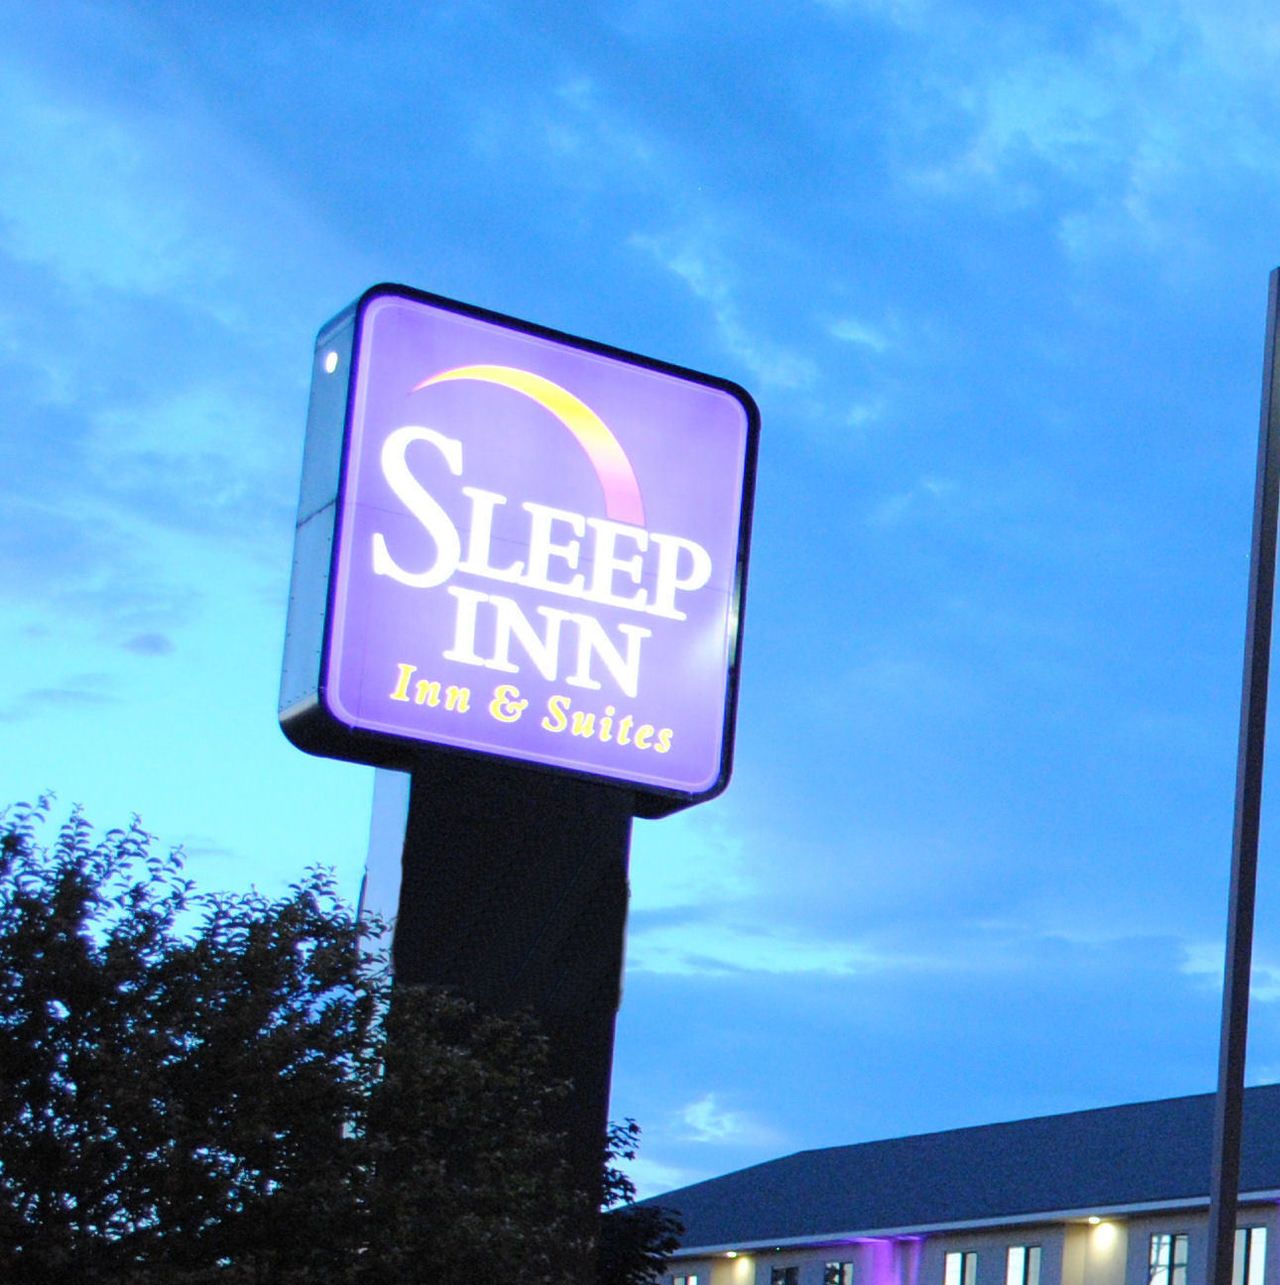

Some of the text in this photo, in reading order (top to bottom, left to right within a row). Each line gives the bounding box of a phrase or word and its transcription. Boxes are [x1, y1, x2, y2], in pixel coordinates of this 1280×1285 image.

[372, 426, 712, 621] SLEEP
[443, 586, 652, 698] INN
[390, 664, 674, 754] Inn & Suites
